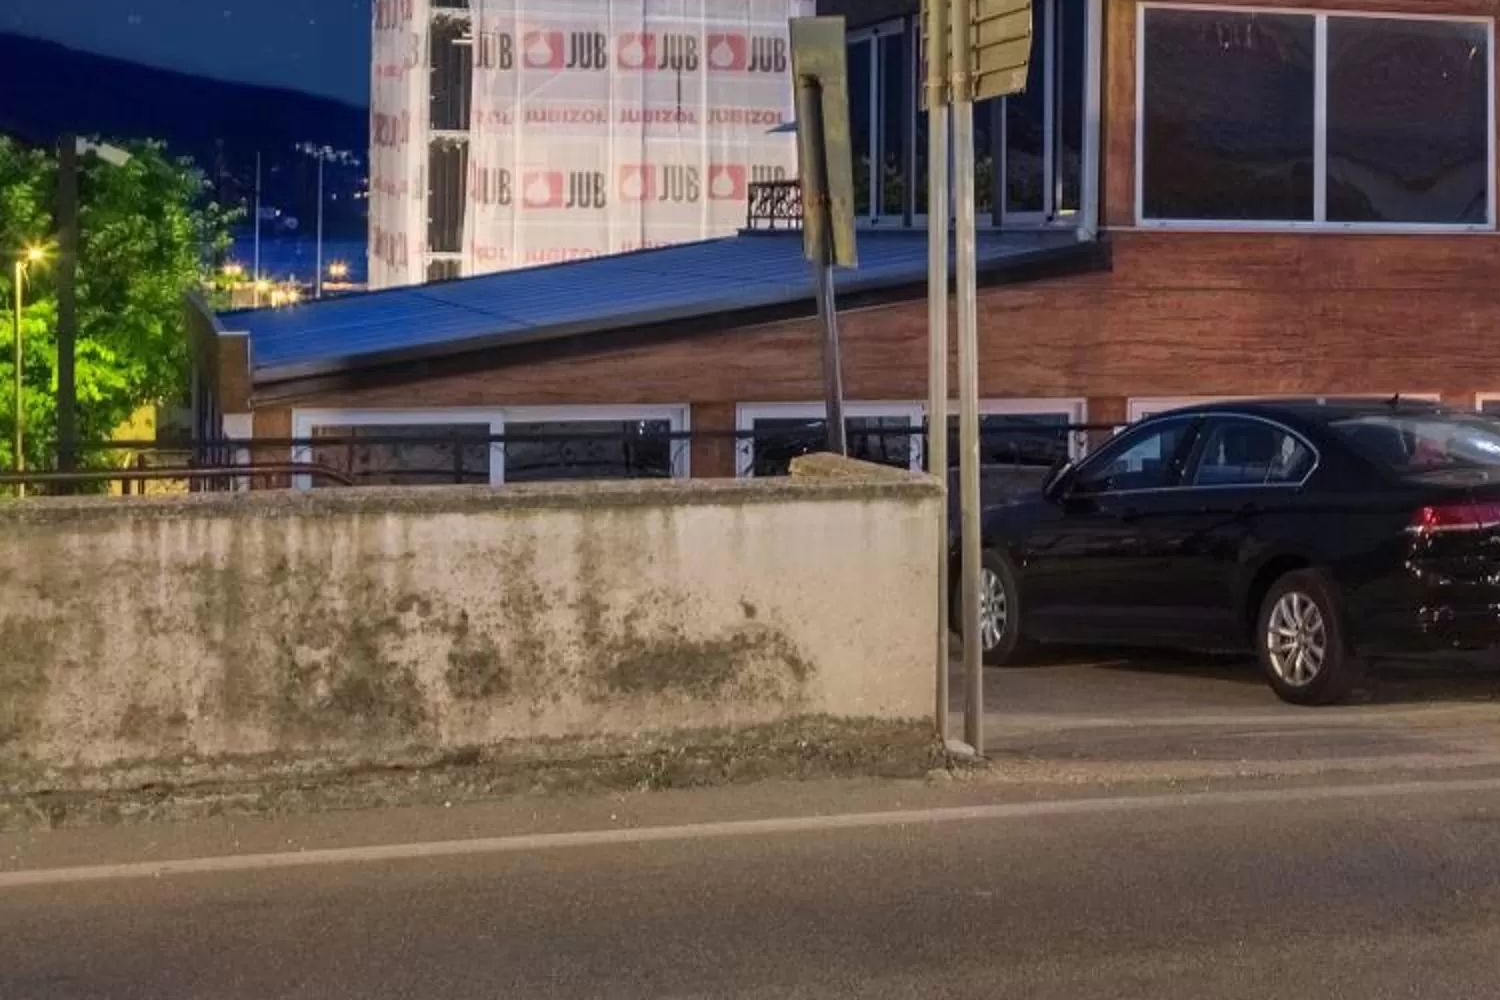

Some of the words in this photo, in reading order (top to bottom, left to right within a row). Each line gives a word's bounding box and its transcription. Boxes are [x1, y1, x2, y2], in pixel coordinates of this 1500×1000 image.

[565, 31, 608, 70] JUB
[657, 33, 699, 72] JUB
[747, 35, 787, 73] JUB
[565, 171, 607, 209] JUB
[658, 164, 700, 203] JUB
